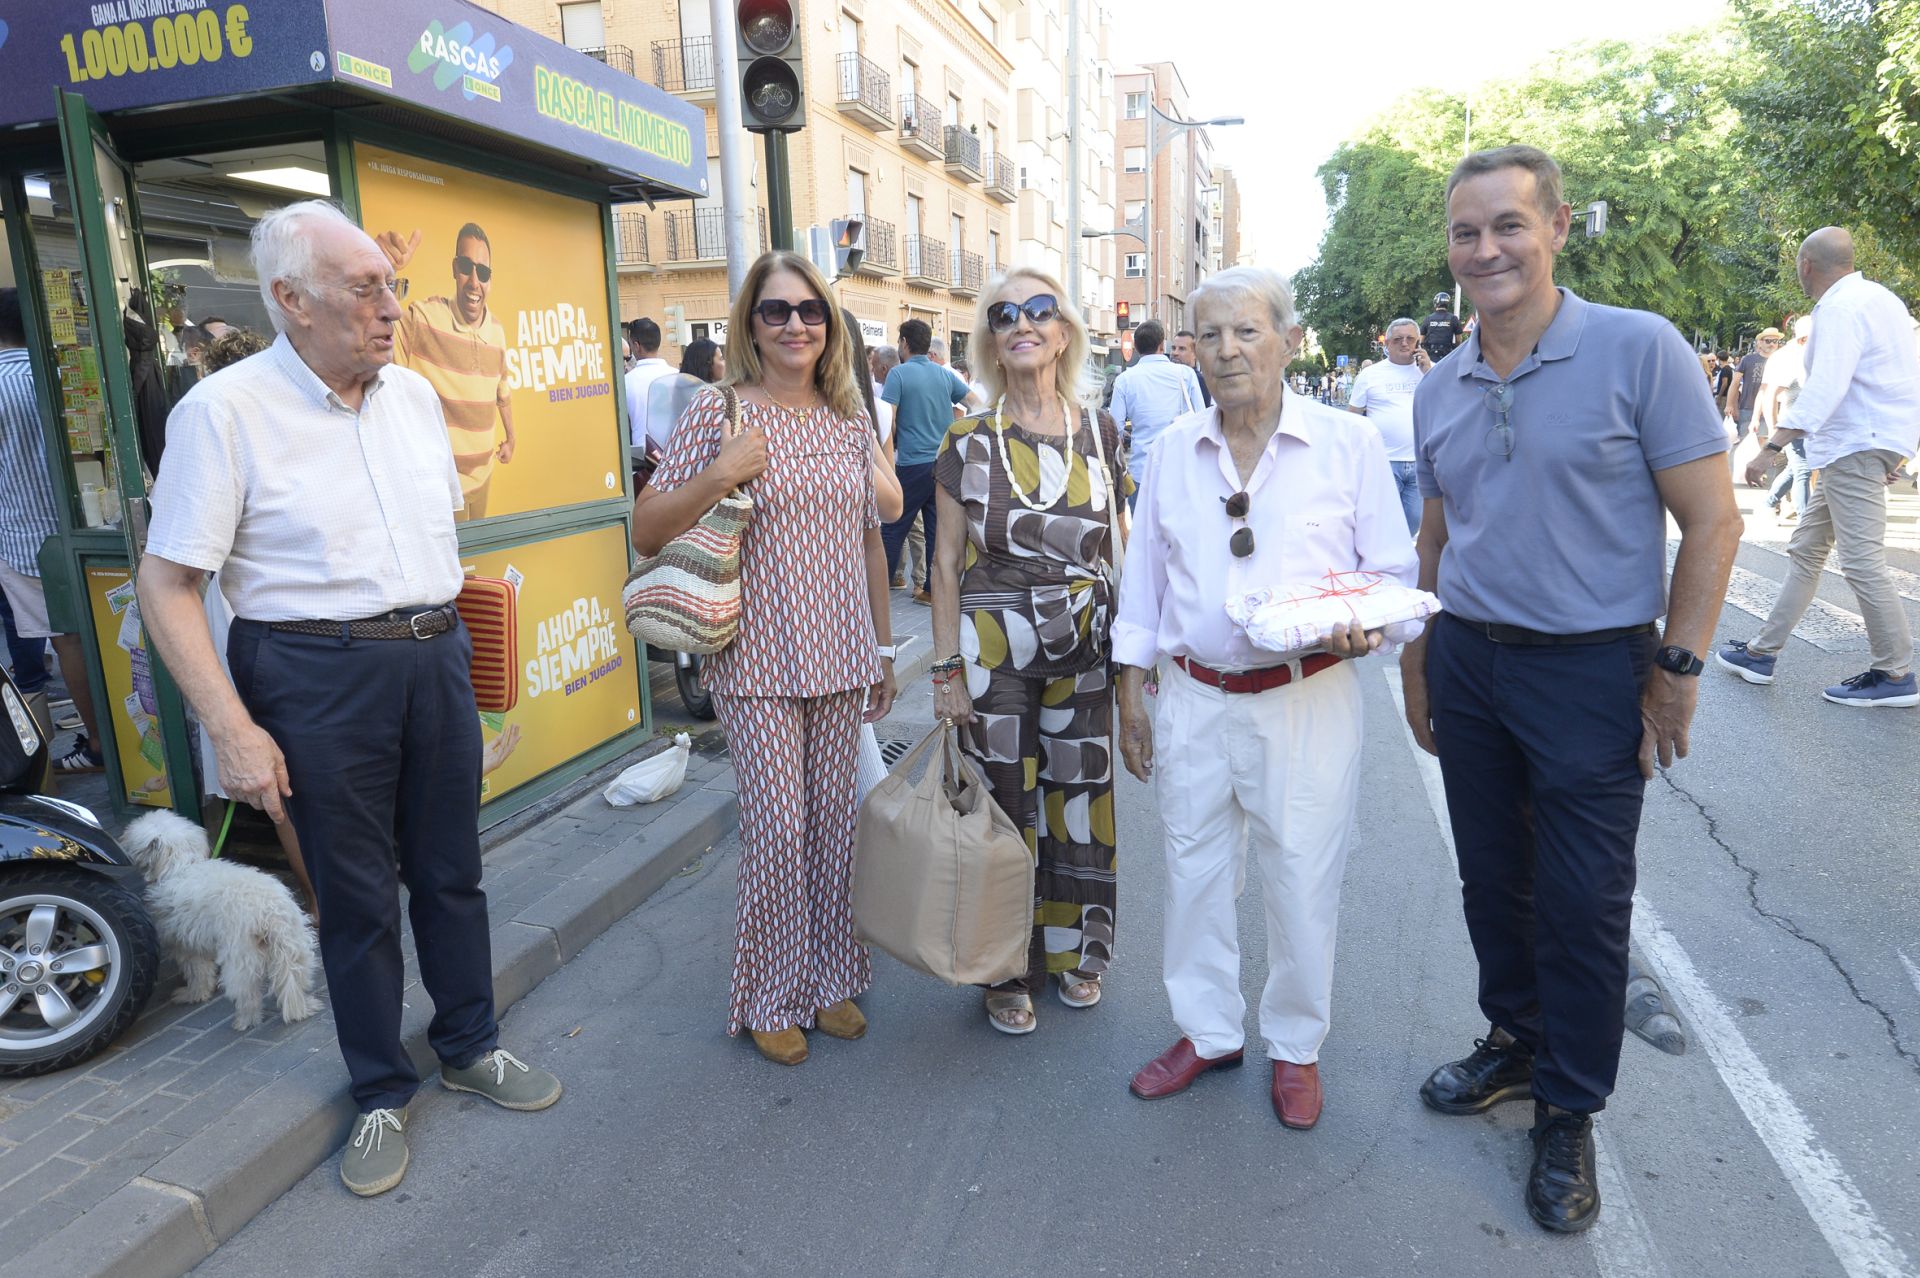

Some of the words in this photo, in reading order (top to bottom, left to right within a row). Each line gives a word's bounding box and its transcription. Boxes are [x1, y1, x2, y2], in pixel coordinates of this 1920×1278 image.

[91, 3, 118, 26] GANA
[118, 1, 130, 21] AL
[129, 0, 175, 19] INSTANTE
[60, 9, 223, 83] 1.000.000
[225, 4, 253, 58] €
[420, 29, 500, 80] RASCAS
[354, 62, 389, 84] ONCE
[474, 82, 499, 98] ONCE
[536, 66, 598, 132] RASCA
[598, 92, 621, 141] EL
[620, 101, 691, 167] MOMENTO
[517, 303, 589, 347] AHORA
[714, 322, 728, 335] Pa
[863, 322, 884, 337] Palmeral
[505, 339, 605, 392] SIEMPRE
[549, 388, 573, 403] BIEN
[575, 383, 610, 400] JUGADO
[537, 596, 602, 656] AHORA
[525, 621, 618, 698] SIEMPRE
[565, 676, 587, 696] BIEN
[589, 656, 622, 684] JUGADO
